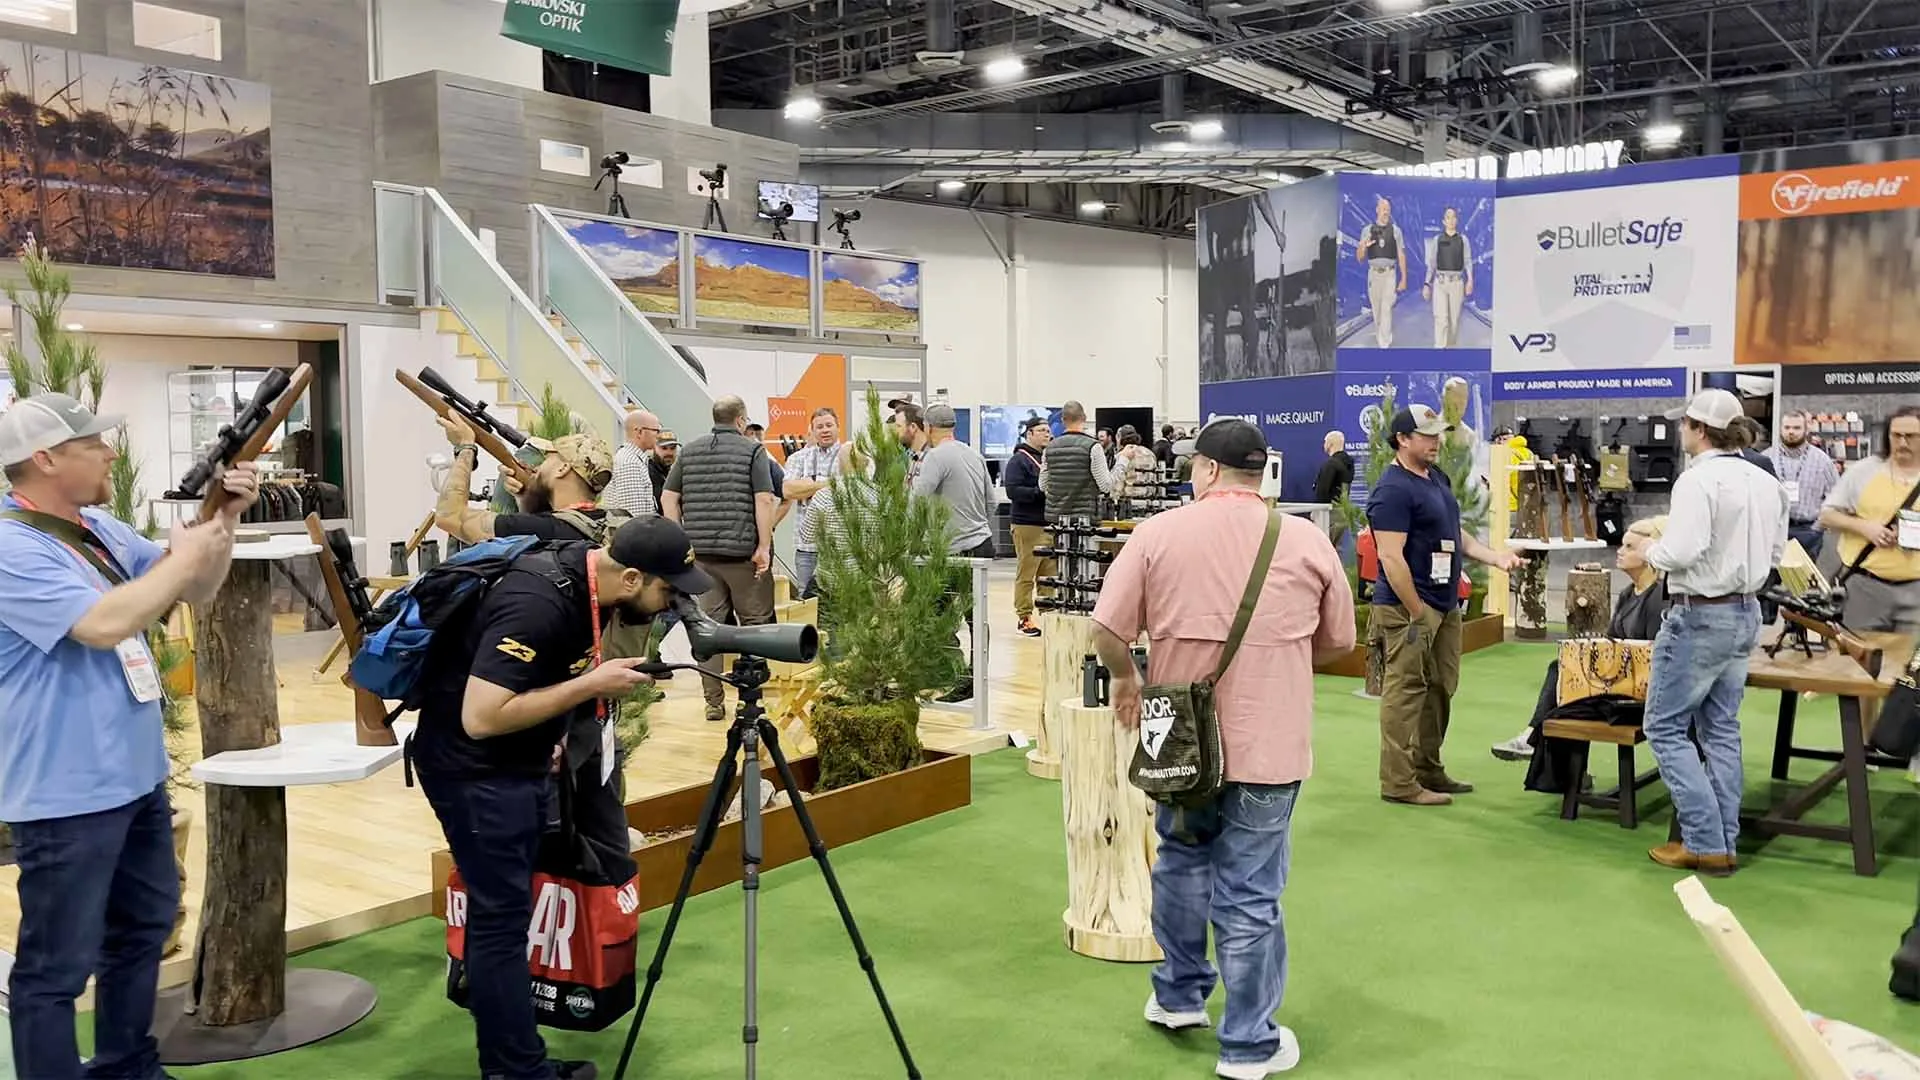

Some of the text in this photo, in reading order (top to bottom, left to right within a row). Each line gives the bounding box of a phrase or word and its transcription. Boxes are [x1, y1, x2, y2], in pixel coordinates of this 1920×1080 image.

[539, 11, 583, 34] OPTIK
[1507, 139, 1624, 179] ARMORY
[1795, 176, 1903, 202] Firefield
[1558, 216, 1684, 250] BulletSafe
[1574, 273, 1602, 286] VITAL
[1573, 282, 1651, 297] PROTECTION
[1503, 377, 1674, 391] BODY ARMOR PROUDLY MADE IN AMERICA
[1824, 372, 1856, 385] OPTICS
[1856, 372, 1875, 385] AND
